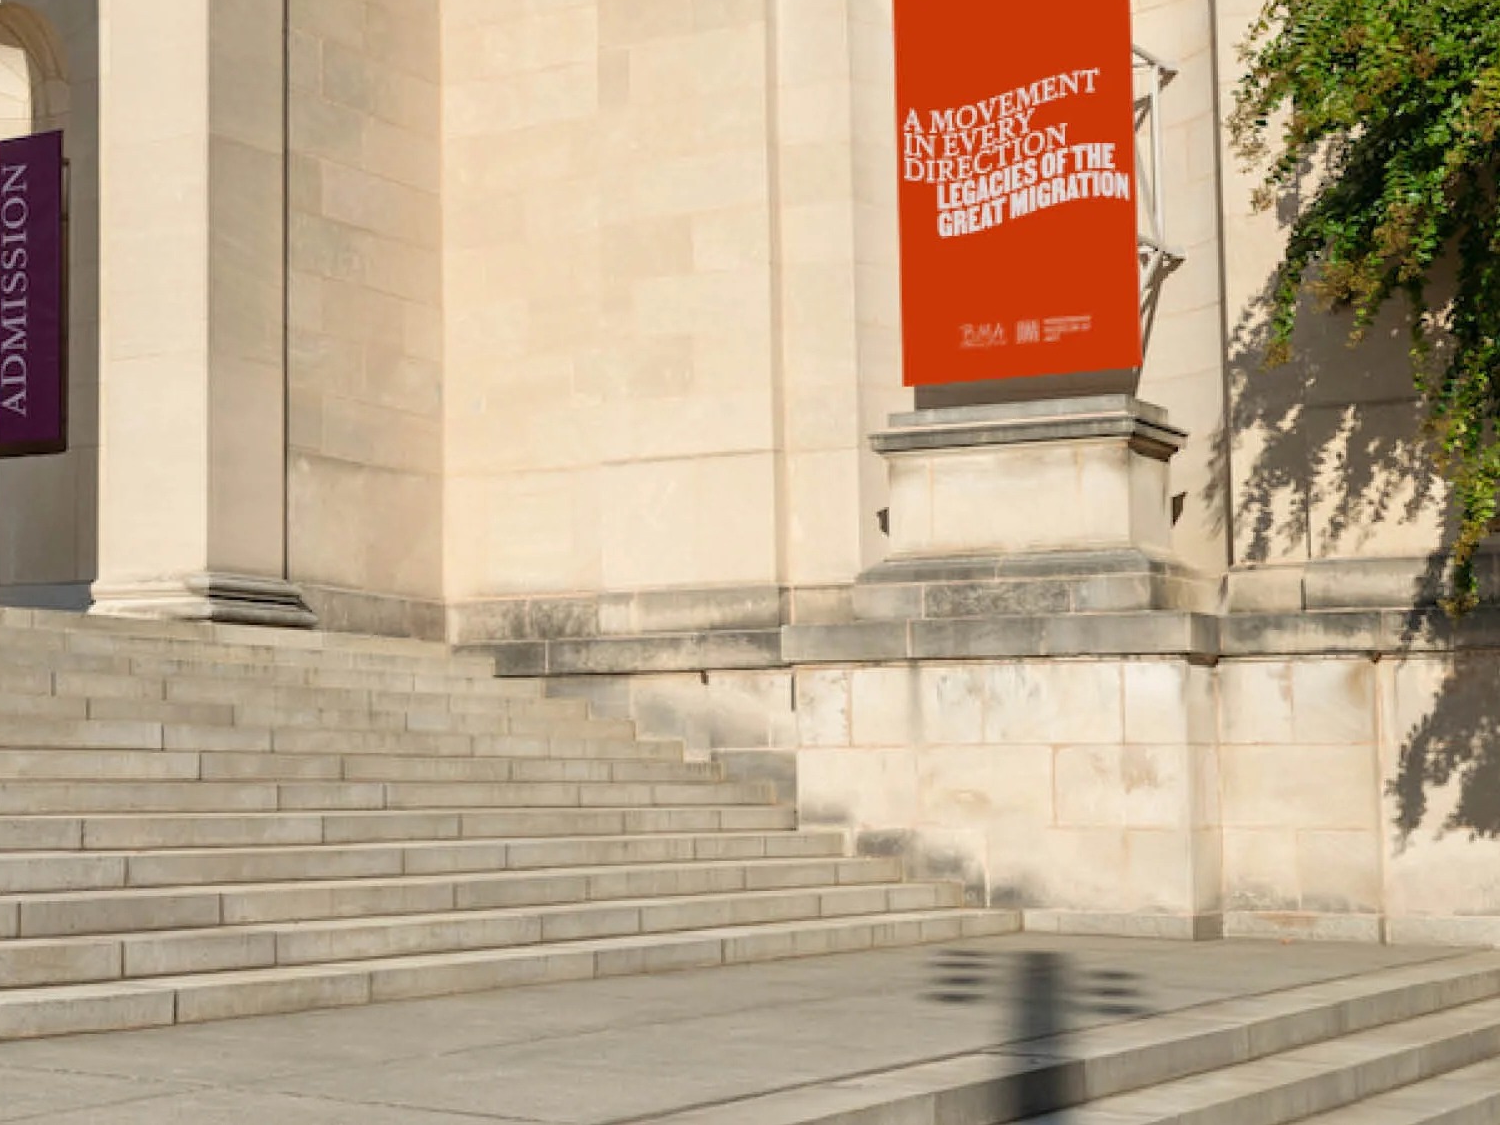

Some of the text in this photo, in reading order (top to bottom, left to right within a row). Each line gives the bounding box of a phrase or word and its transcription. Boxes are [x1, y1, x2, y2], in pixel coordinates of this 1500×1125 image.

[903, 67, 1100, 134] A MOVEMENT
[903, 107, 1036, 158] IN EVERY
[903, 122, 1068, 183] DIRECTION
[937, 142, 1116, 210] LEGACIES OF THE
[937, 171, 1130, 239] GREAT MIGRATION
[0, 163, 29, 418] ADMISSION
